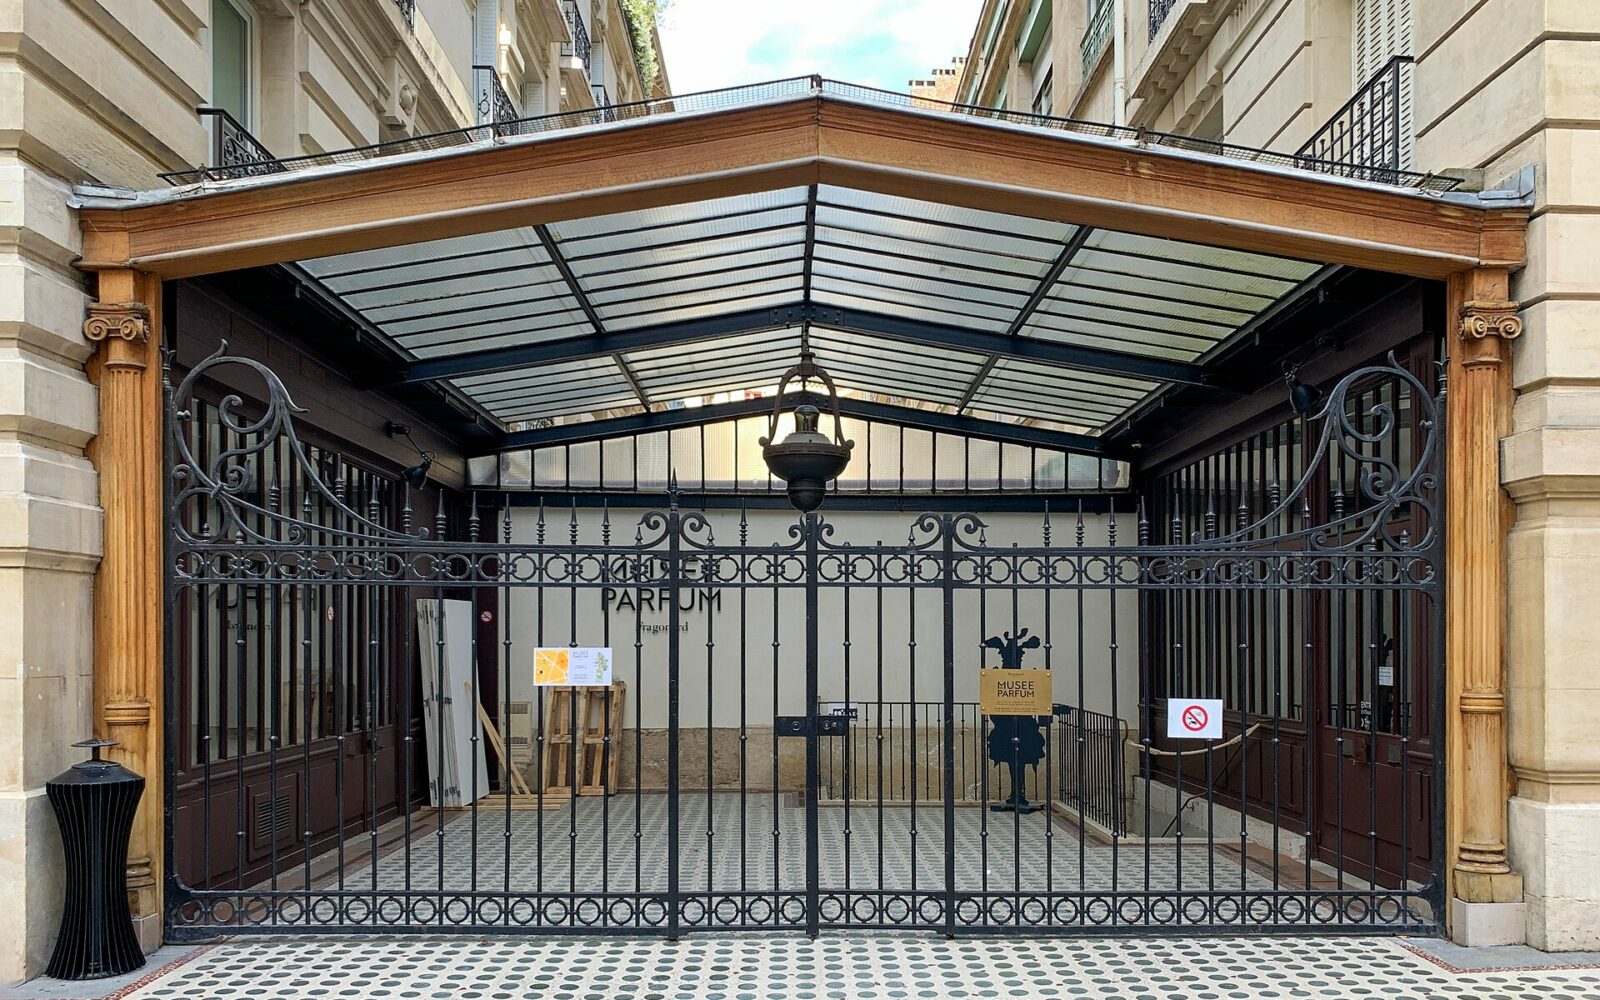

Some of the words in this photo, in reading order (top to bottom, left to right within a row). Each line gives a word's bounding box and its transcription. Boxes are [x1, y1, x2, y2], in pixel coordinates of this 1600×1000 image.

[601, 587, 721, 611] PARFUM
[997, 681, 1035, 690] MUSEE
[997, 690, 1035, 698] PARFUM
